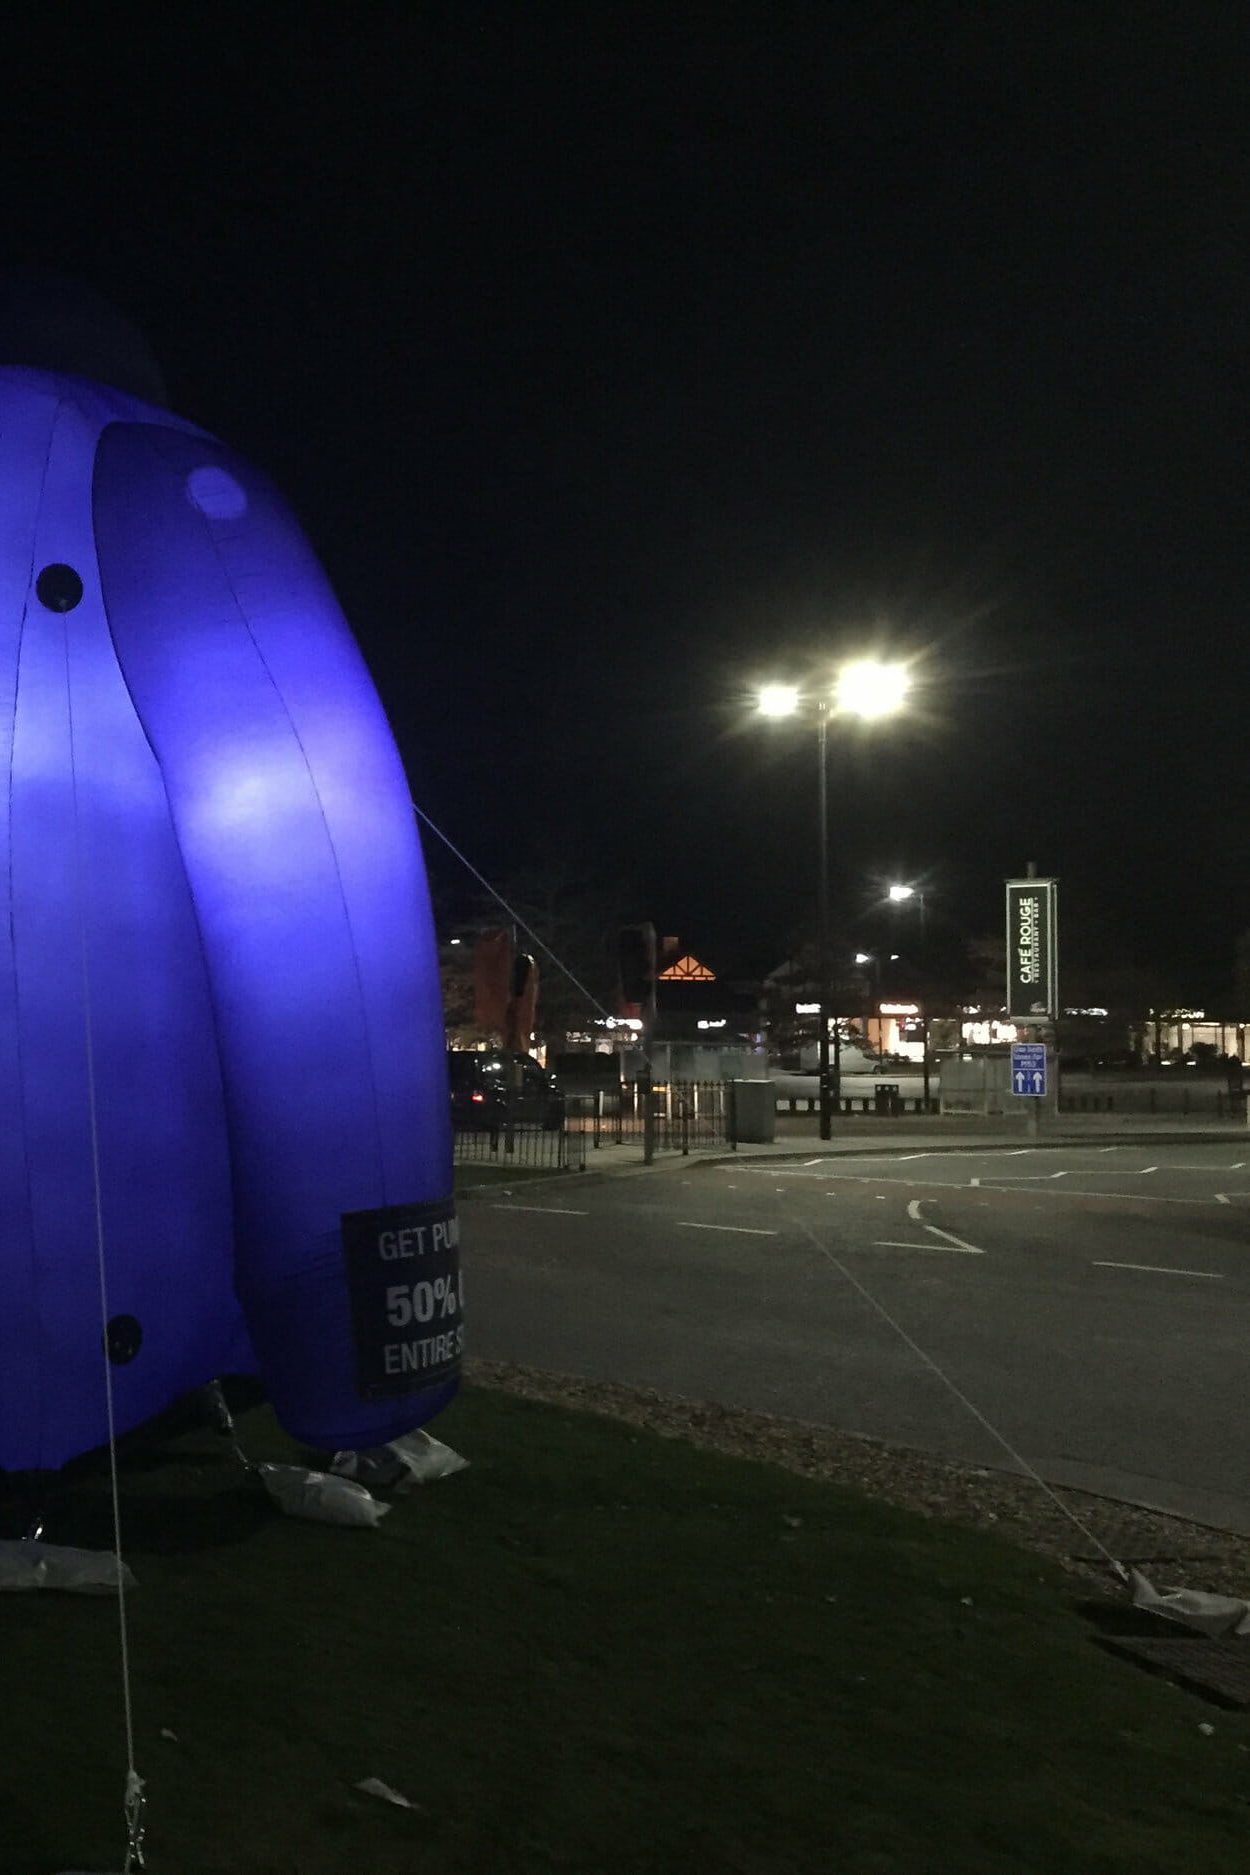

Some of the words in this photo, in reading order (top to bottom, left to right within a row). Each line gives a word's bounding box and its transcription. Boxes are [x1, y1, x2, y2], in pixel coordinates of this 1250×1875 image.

[1019, 897, 1031, 945] ROUGE
[1018, 948, 1031, 984] CAFÉ
[378, 1226, 427, 1261] GET
[386, 1275, 456, 1327] 50%
[384, 1330, 454, 1375] ENTIRE
